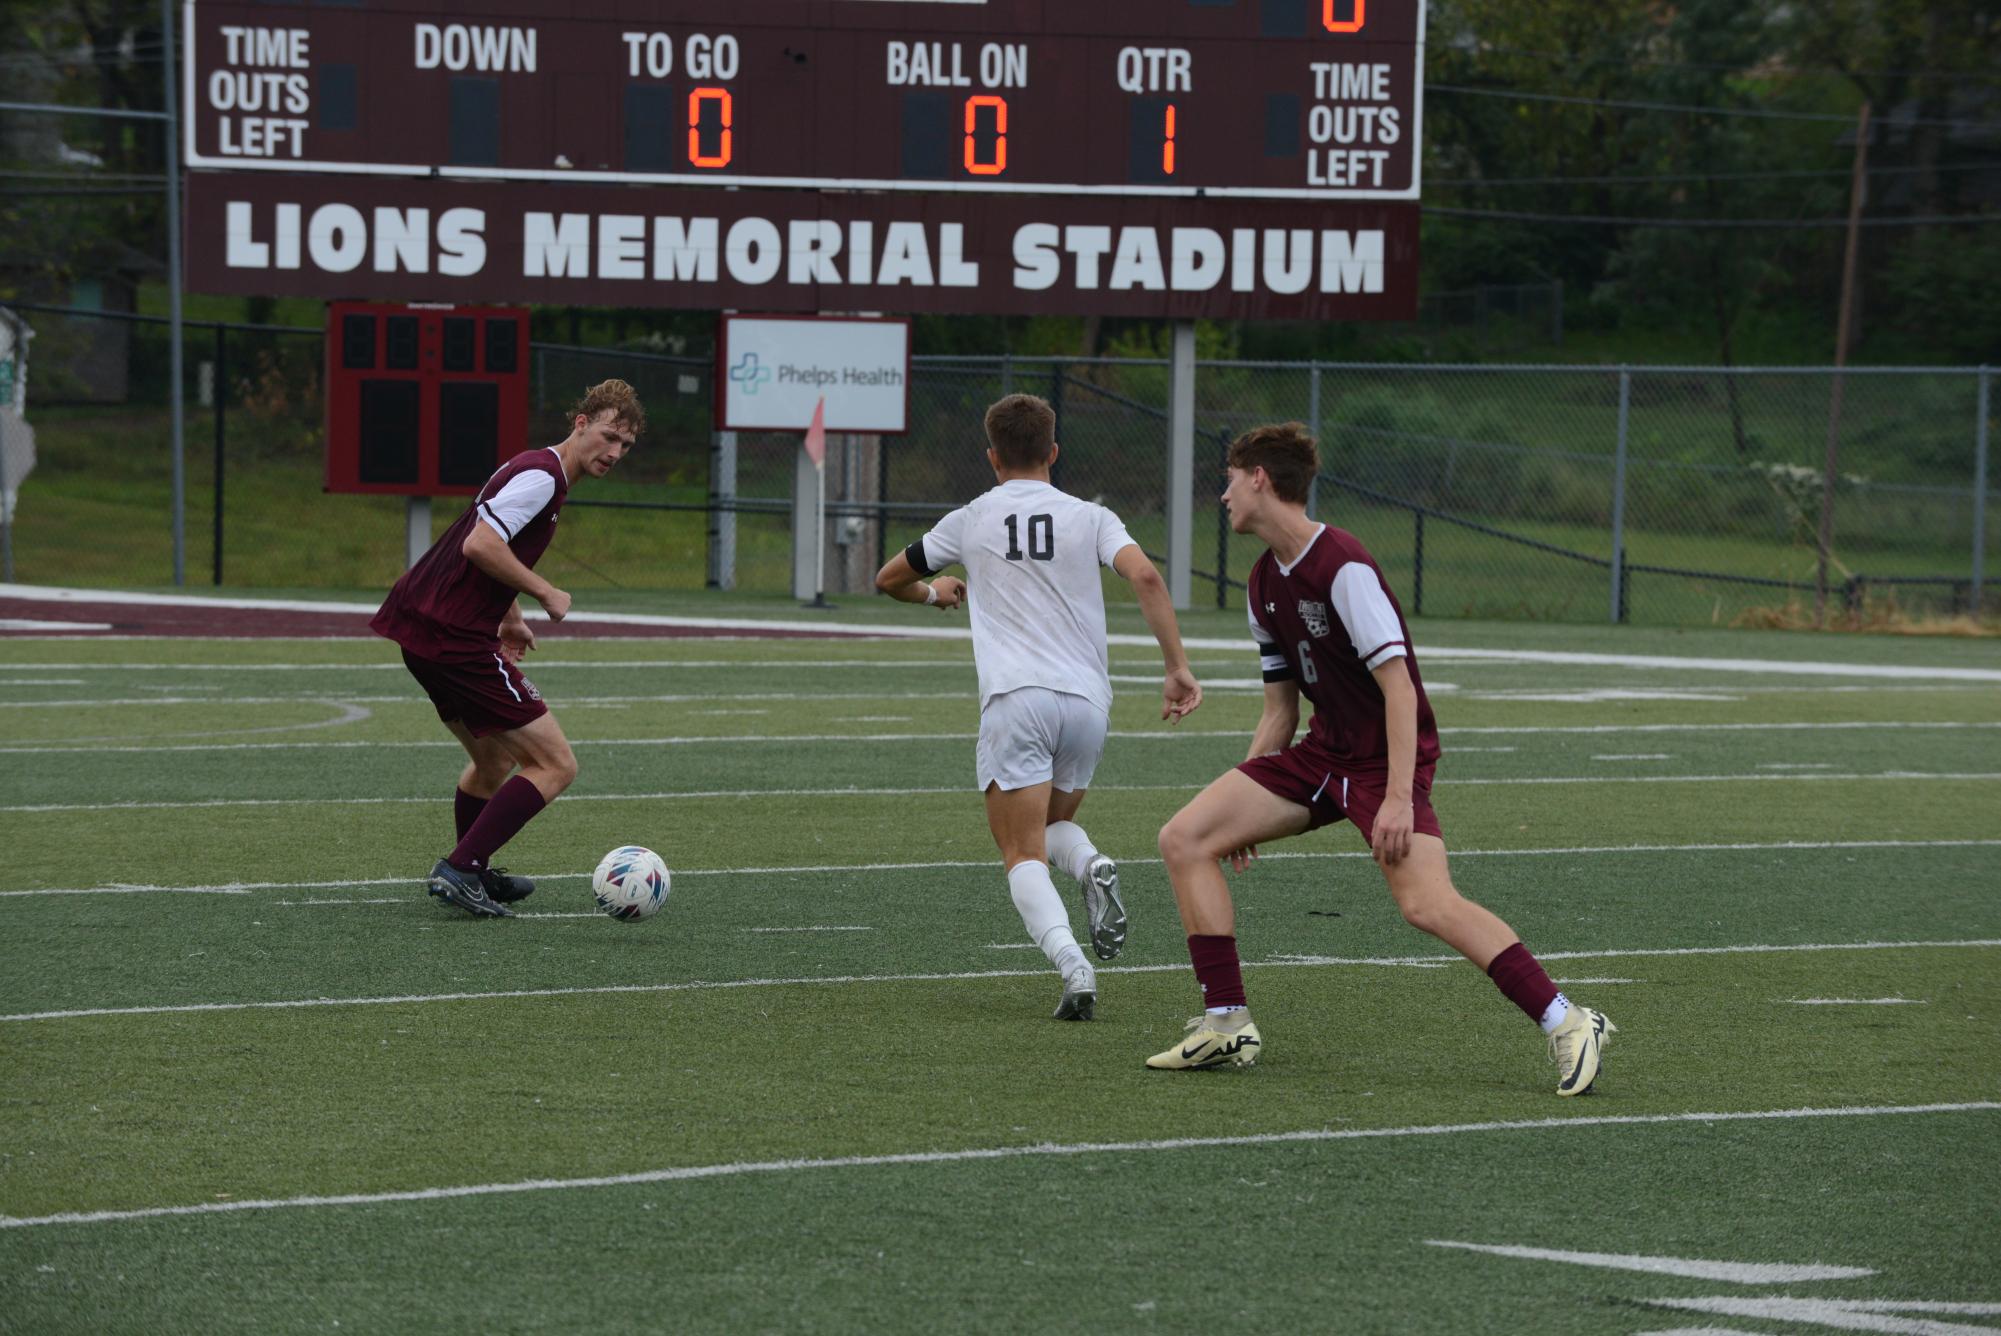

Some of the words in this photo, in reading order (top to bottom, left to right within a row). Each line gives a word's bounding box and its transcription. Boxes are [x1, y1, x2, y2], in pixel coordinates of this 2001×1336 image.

[220, 27, 310, 68] TIME
[415, 24, 537, 72] DOWN
[622, 33, 673, 77] TO
[685, 34, 739, 79] GO
[887, 42, 972, 87] BALL
[980, 43, 1028, 88] ON
[1117, 47, 1192, 94] QTR
[209, 70, 310, 114] OUTS
[1309, 63, 1391, 101] TIME
[219, 116, 310, 157] LEFT
[688, 87, 732, 168] 0
[964, 95, 1007, 175] 0
[1162, 104, 1176, 174] 1
[1308, 105, 1400, 145] OUTS
[1307, 149, 1390, 187] LEFT
[226, 202, 487, 276] LIONS
[523, 212, 979, 286] MEMORIAL
[1012, 223, 1385, 294] STADIUM
[777, 365, 837, 387] Phelps
[842, 366, 903, 386] Health
[1004, 513, 1054, 561] 10
[1297, 640, 1318, 684] 6
